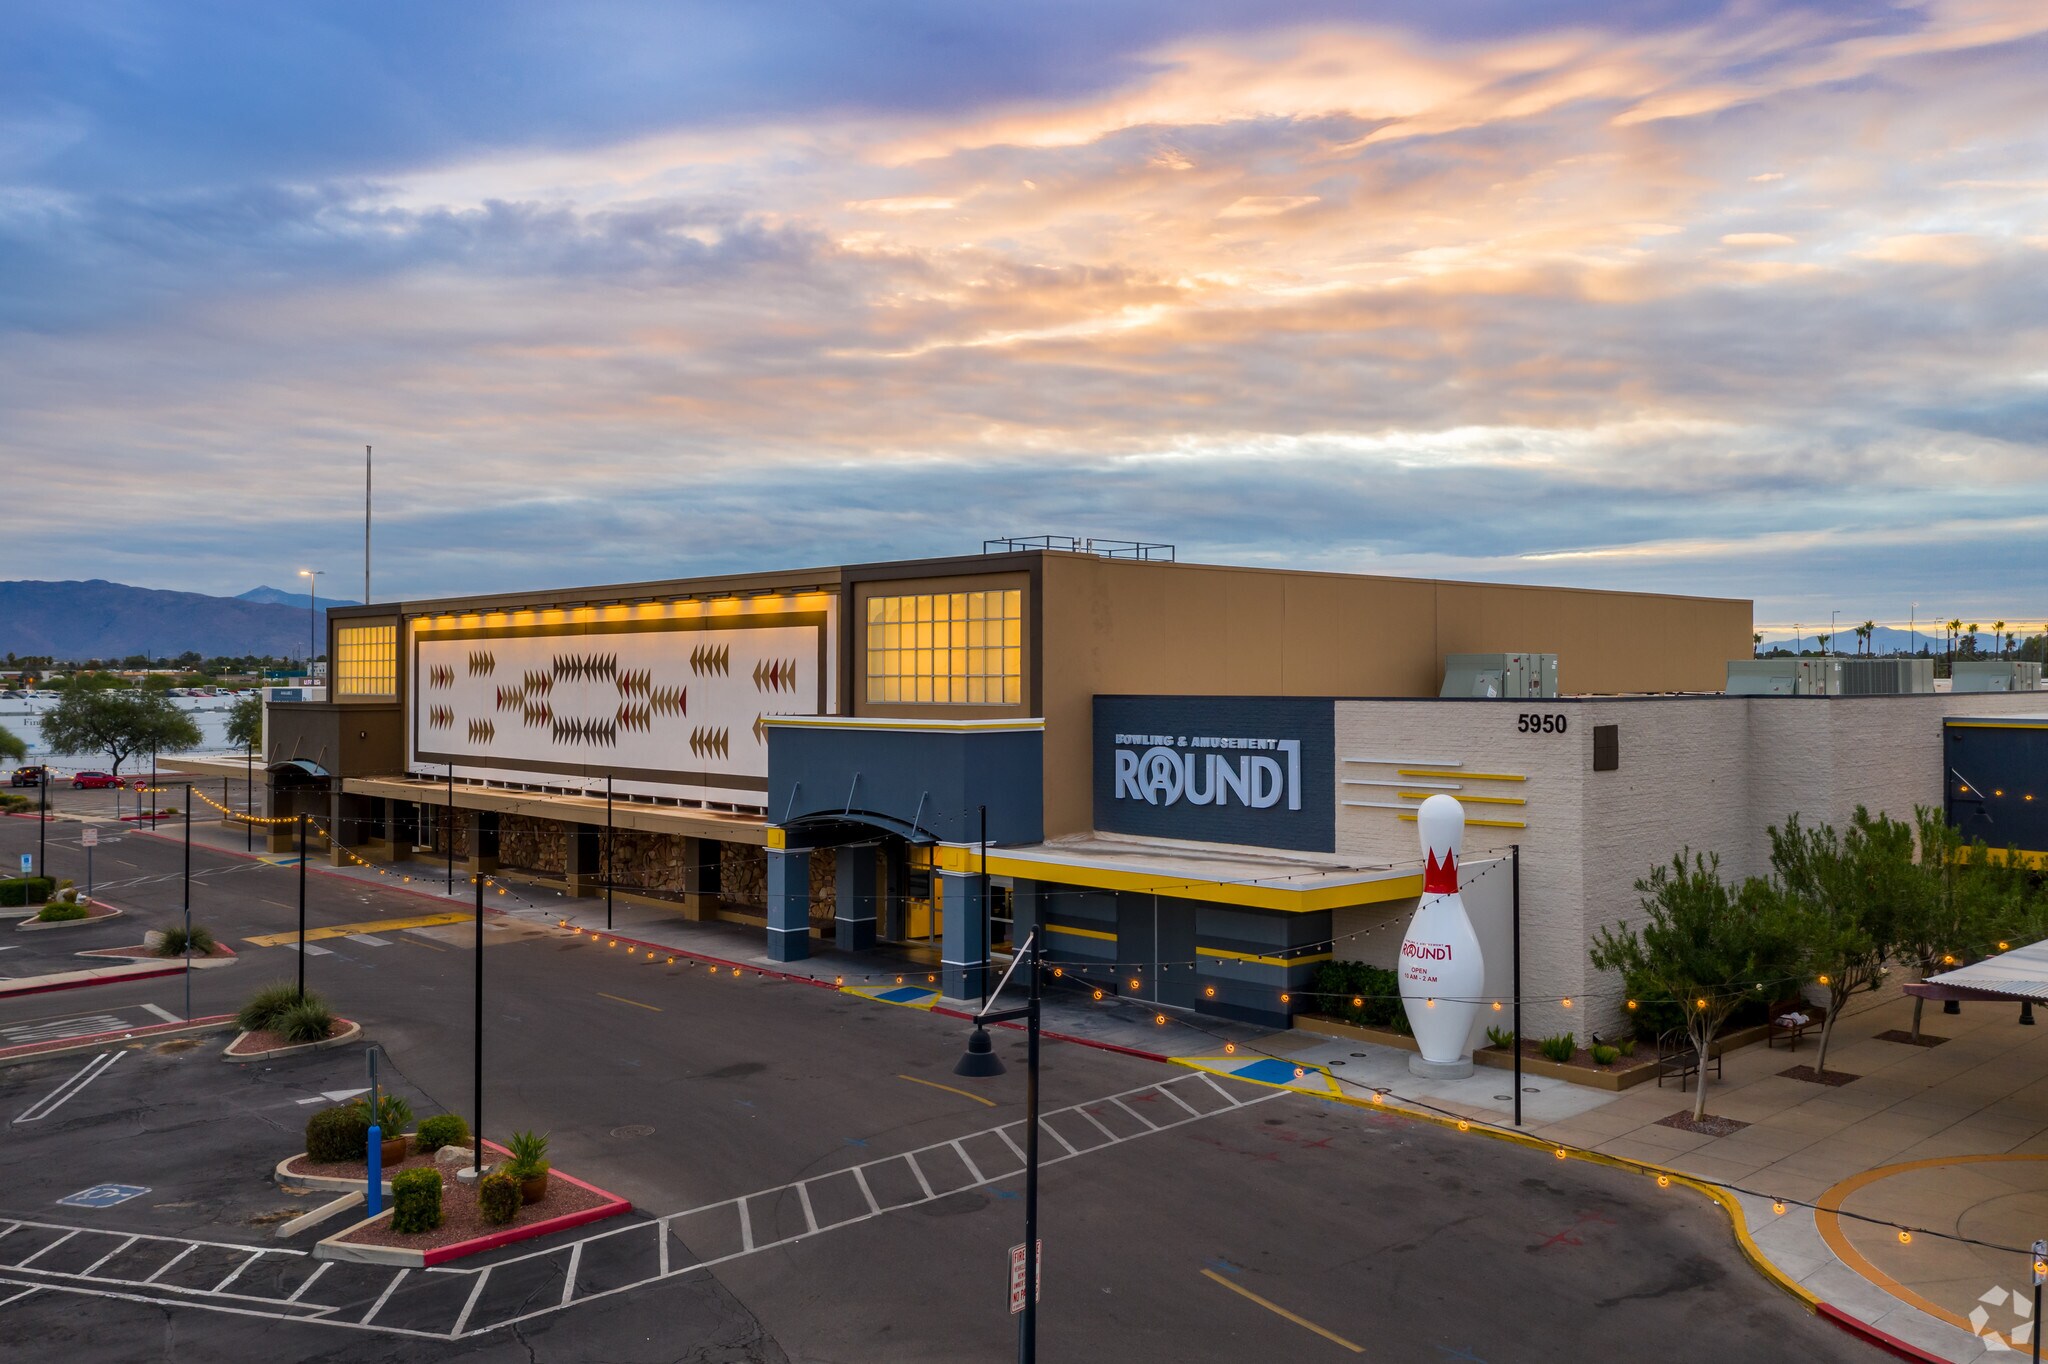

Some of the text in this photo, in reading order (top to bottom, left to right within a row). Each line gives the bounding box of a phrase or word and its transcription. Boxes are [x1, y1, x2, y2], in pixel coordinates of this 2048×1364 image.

[1518, 714, 1567, 733] 5950
[1115, 734, 1278, 750] BOWLING & AMUSEMENT
[1115, 739, 1302, 811] ROUND1
[1402, 943, 1451, 960] ROUND1
